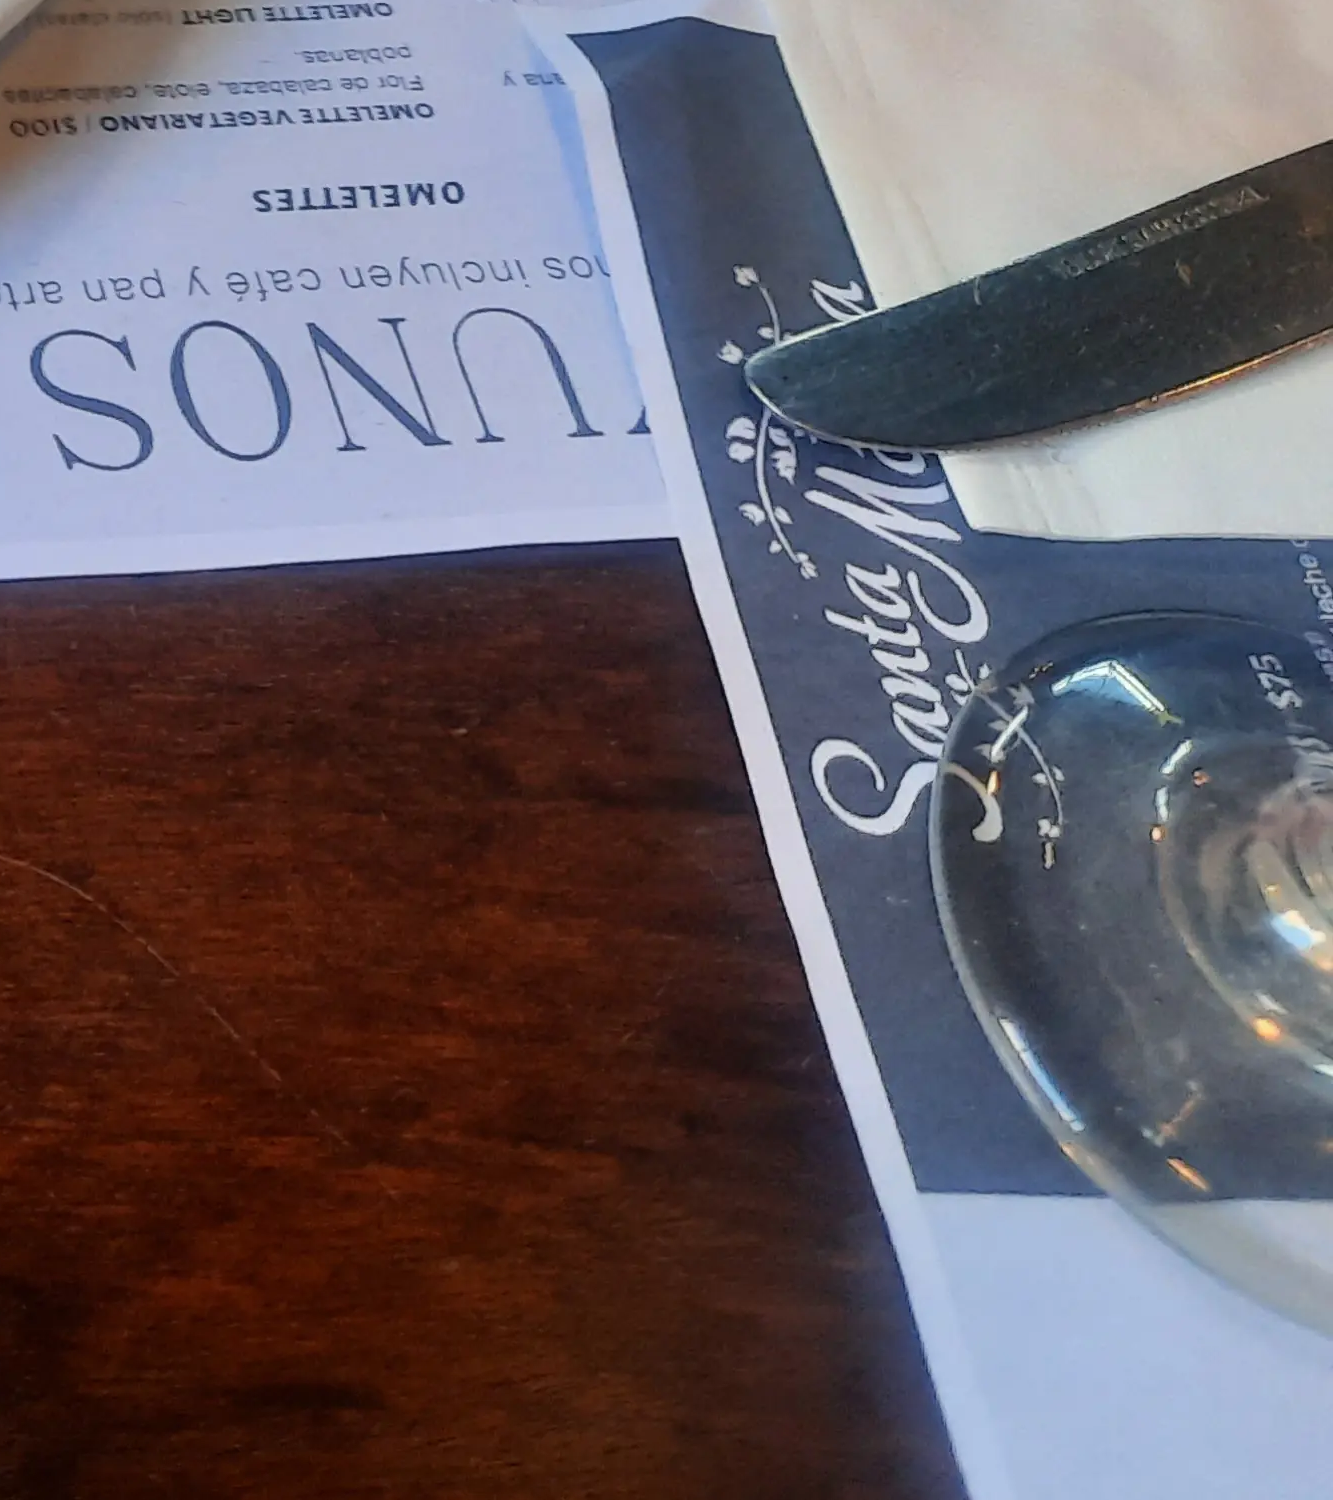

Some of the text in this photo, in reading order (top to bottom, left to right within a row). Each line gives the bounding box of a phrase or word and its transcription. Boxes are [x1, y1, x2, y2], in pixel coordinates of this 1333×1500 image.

[181, 6, 256, 26] LIGHT
[262, 0, 394, 23] OMELETTE
[294, 45, 412, 66] poblanas.
[217, 77, 333, 99] calabaza,
[339, 76, 369, 95] de
[377, 74, 425, 92] Flor
[502, 70, 514, 88] y
[98, 108, 296, 133] VEGETARIANO
[298, 102, 435, 125] OMELETTE
[9, 115, 78, 139] $100
[252, 180, 465, 214] OMELETTES
[82, 271, 165, 300] pan
[187, 266, 211, 296] y
[225, 269, 322, 302] café
[340, 257, 532, 293] incluyen
[29, 307, 651, 472] UNOS
[1247, 652, 1304, 712] $75
[811, 562, 1003, 843] Santa
